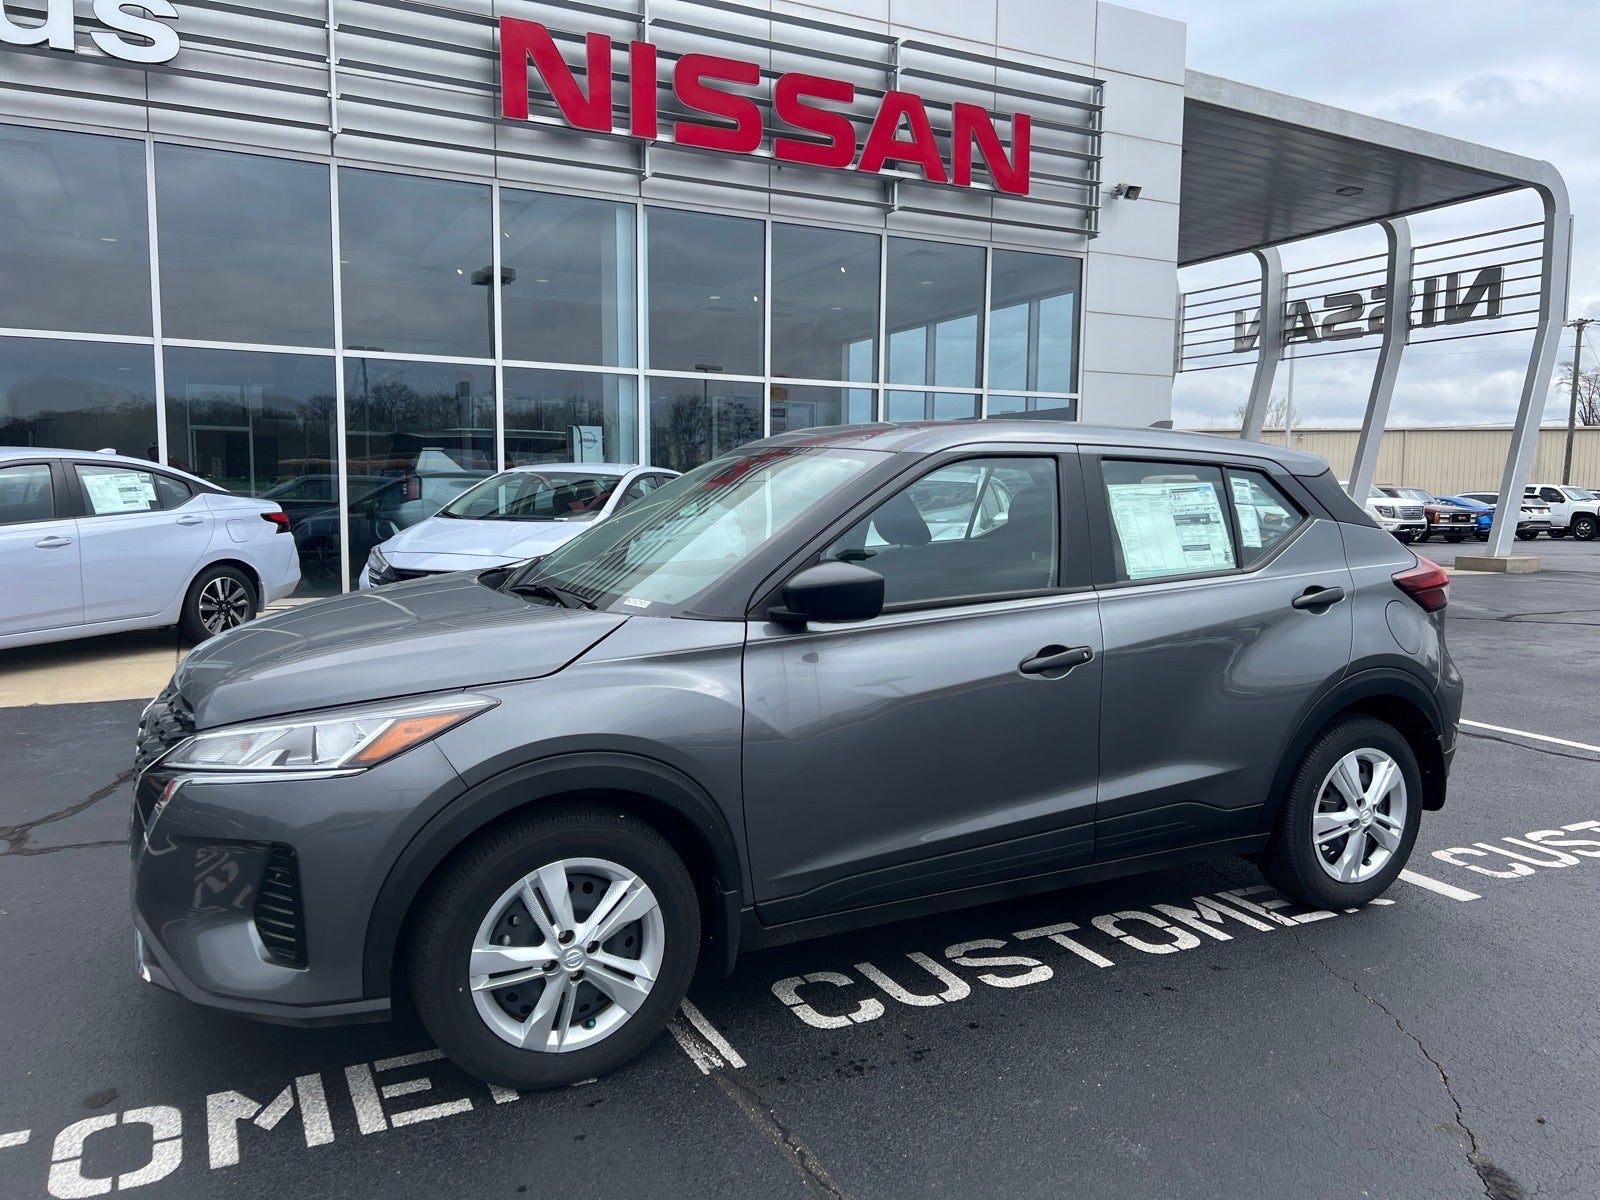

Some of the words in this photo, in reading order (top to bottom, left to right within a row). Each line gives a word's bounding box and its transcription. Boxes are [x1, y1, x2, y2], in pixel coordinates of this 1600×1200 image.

[499, 15, 1032, 196] NISSAN
[771, 884, 1396, 1029] CUSTOME
[0, 1048, 598, 1200] OME
